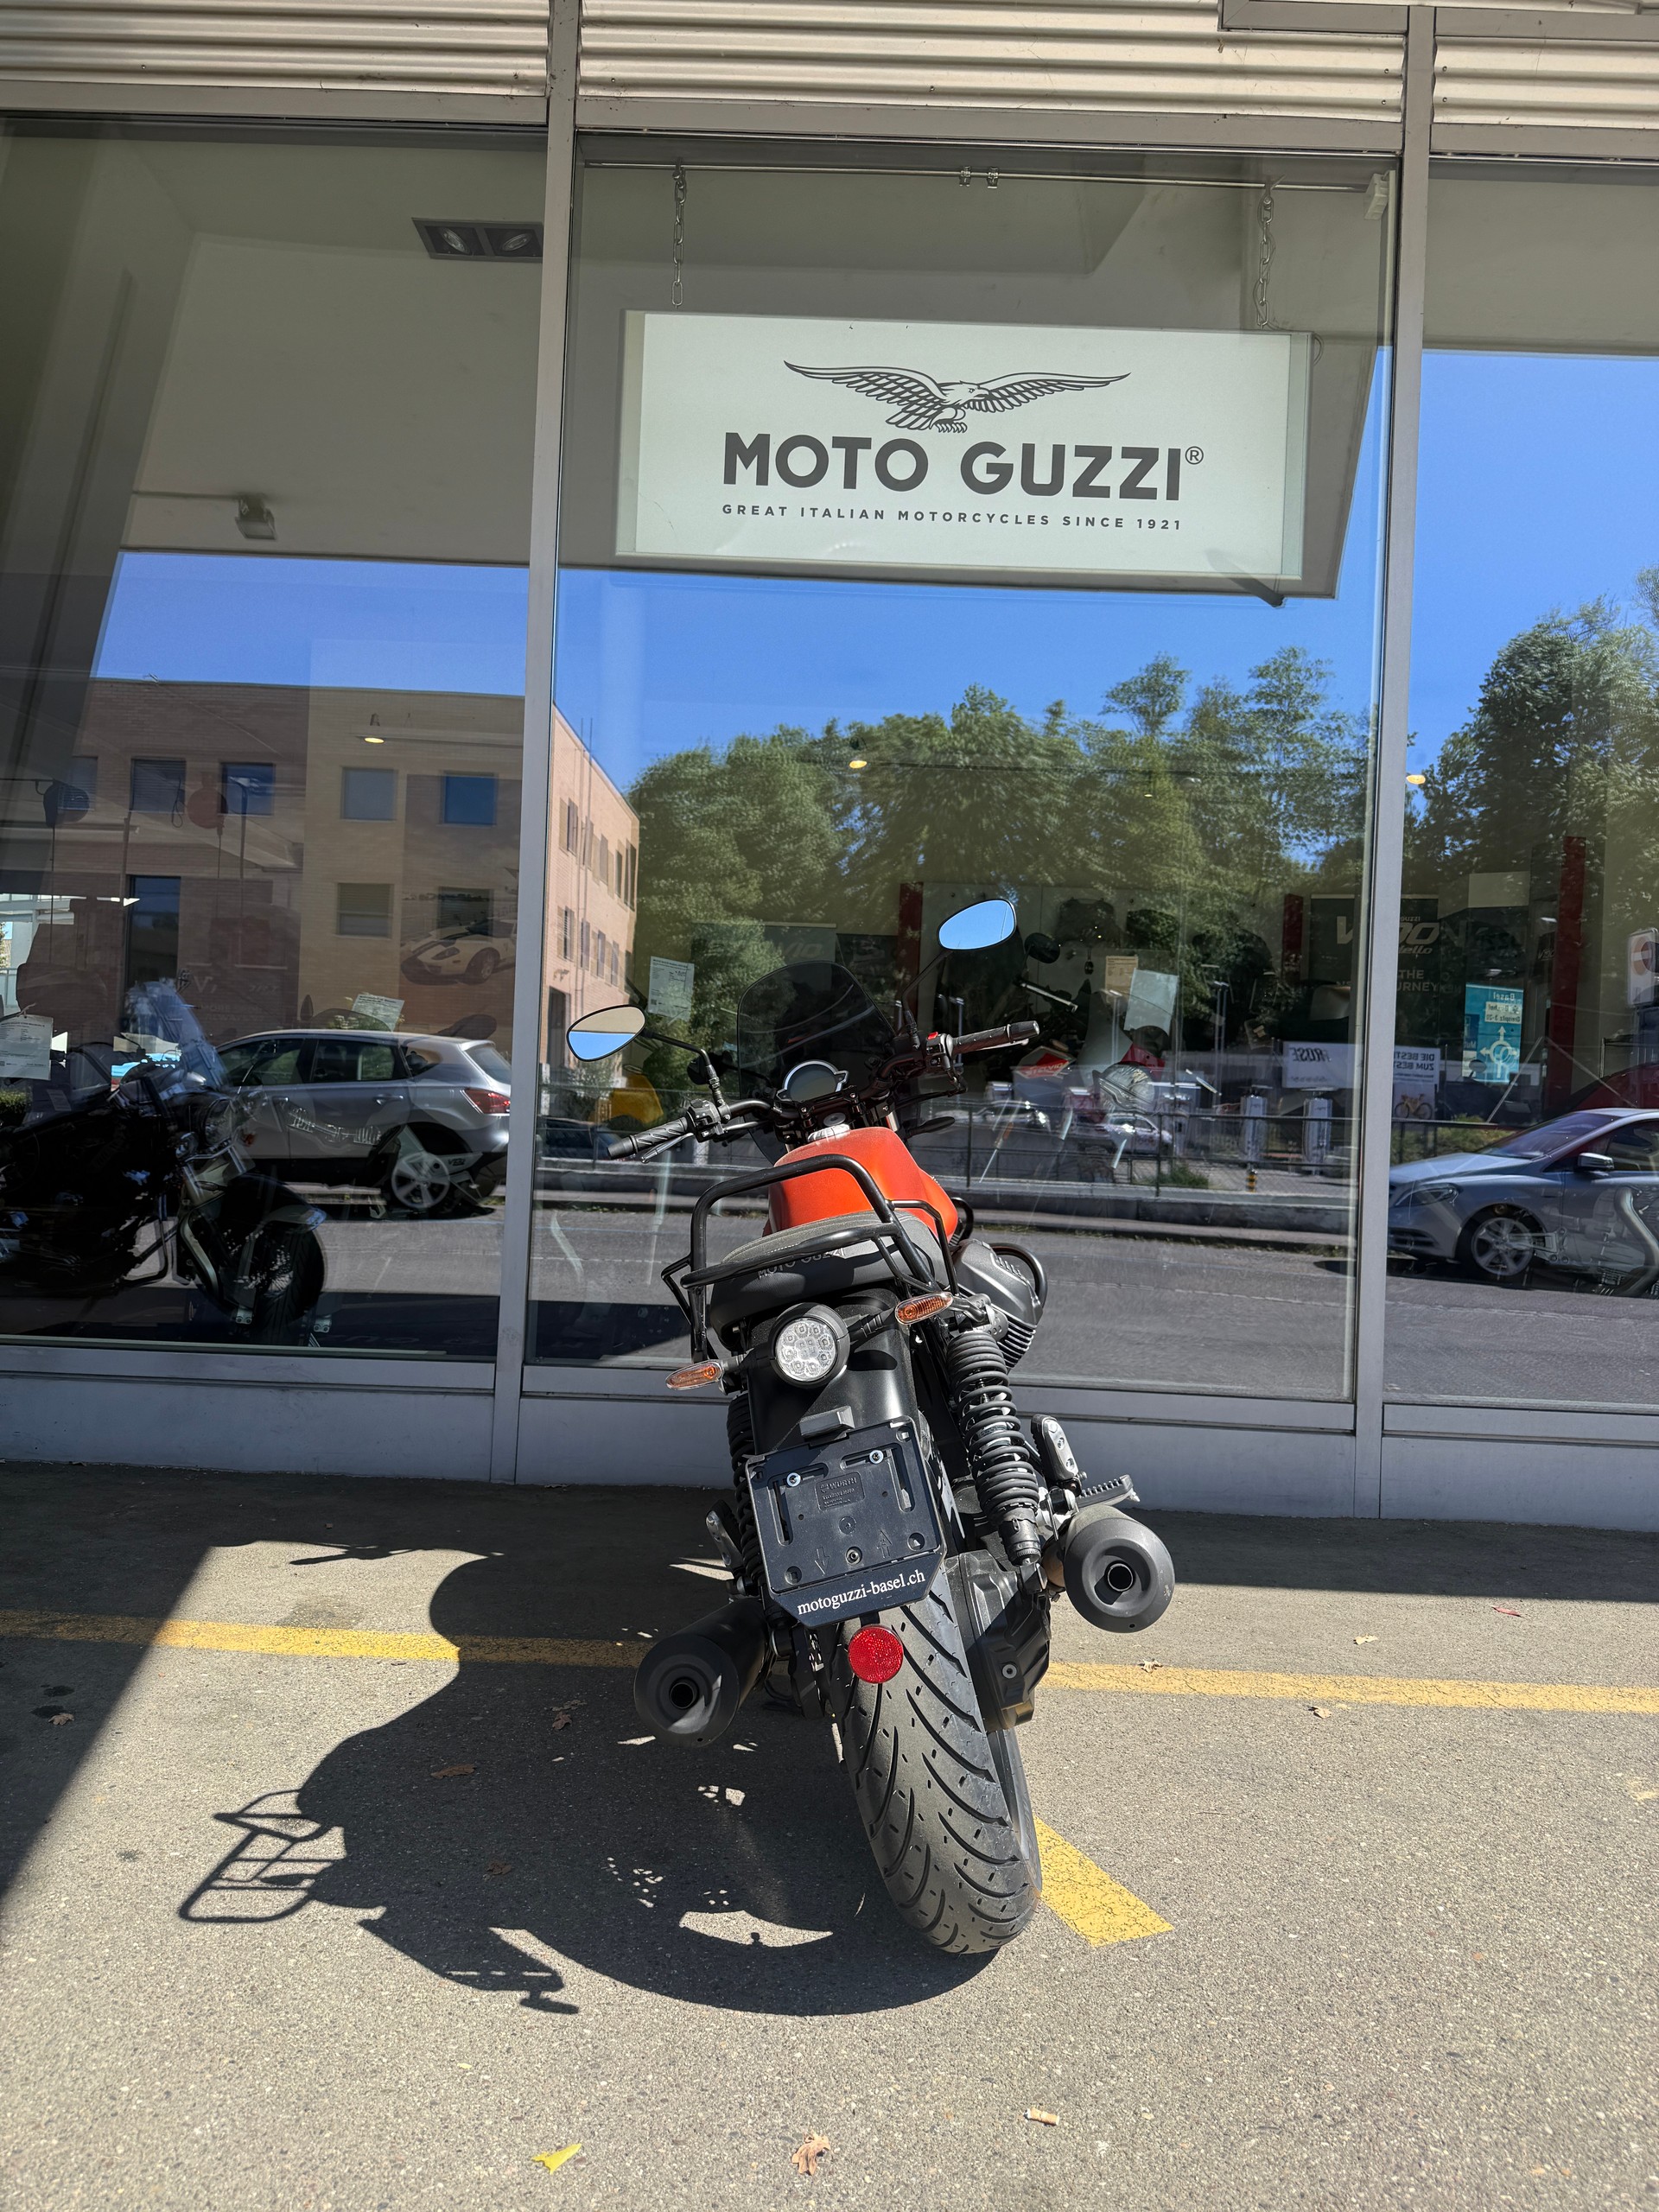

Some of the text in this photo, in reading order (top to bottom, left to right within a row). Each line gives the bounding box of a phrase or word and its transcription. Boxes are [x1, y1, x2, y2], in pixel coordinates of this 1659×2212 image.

[723, 432, 929, 493] MOTO
[722, 504, 1179, 531] GREAT ITALIAN MOTORCYCLES SINCE 1921
[797, 1569, 926, 1616] motoguzzi-basel.ch
